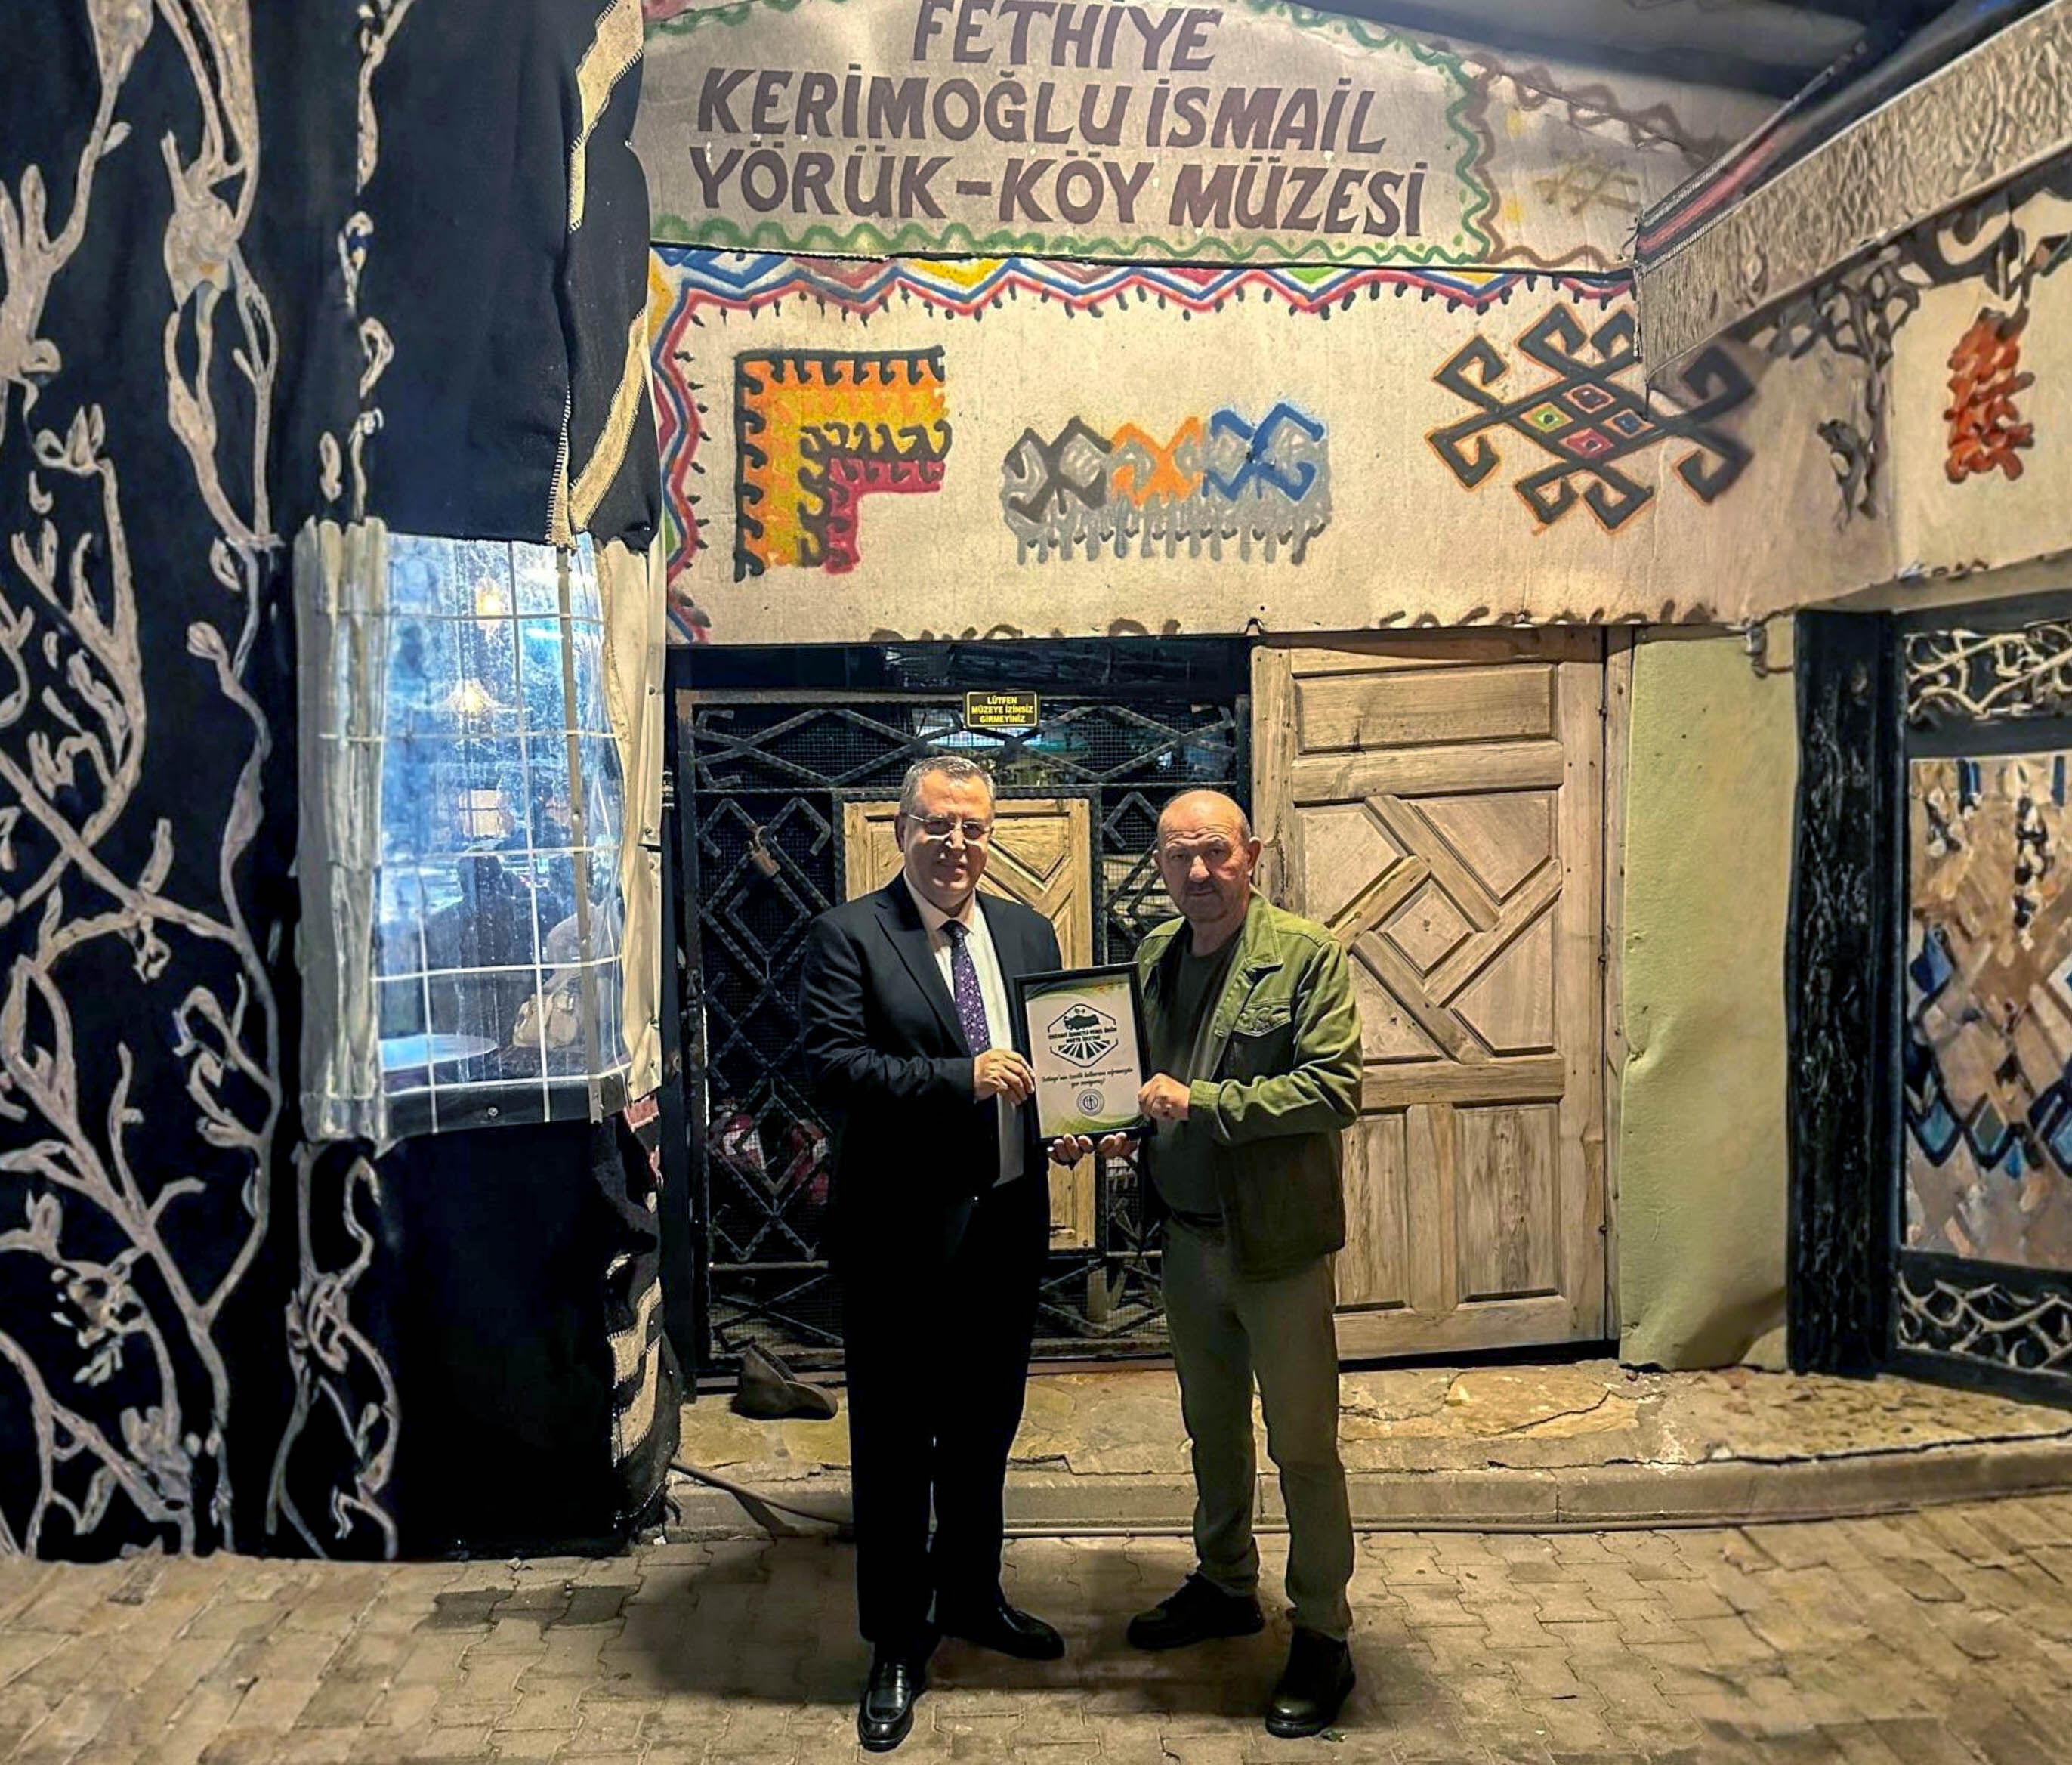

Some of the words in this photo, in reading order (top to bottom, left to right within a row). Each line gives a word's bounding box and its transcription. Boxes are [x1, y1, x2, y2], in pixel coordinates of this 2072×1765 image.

[697, 63, 1132, 147] KERİMOĞLU
[1146, 78, 1387, 153] İSMAİL
[1169, 156, 1427, 237] MÜZESİ
[987, 695, 1017, 704] LÜTFEN
[971, 705, 1003, 714] MÜZEYE
[1005, 704, 1033, 713] İZİNSİZ
[980, 714, 1026, 723] GİRMEYİNİZ
